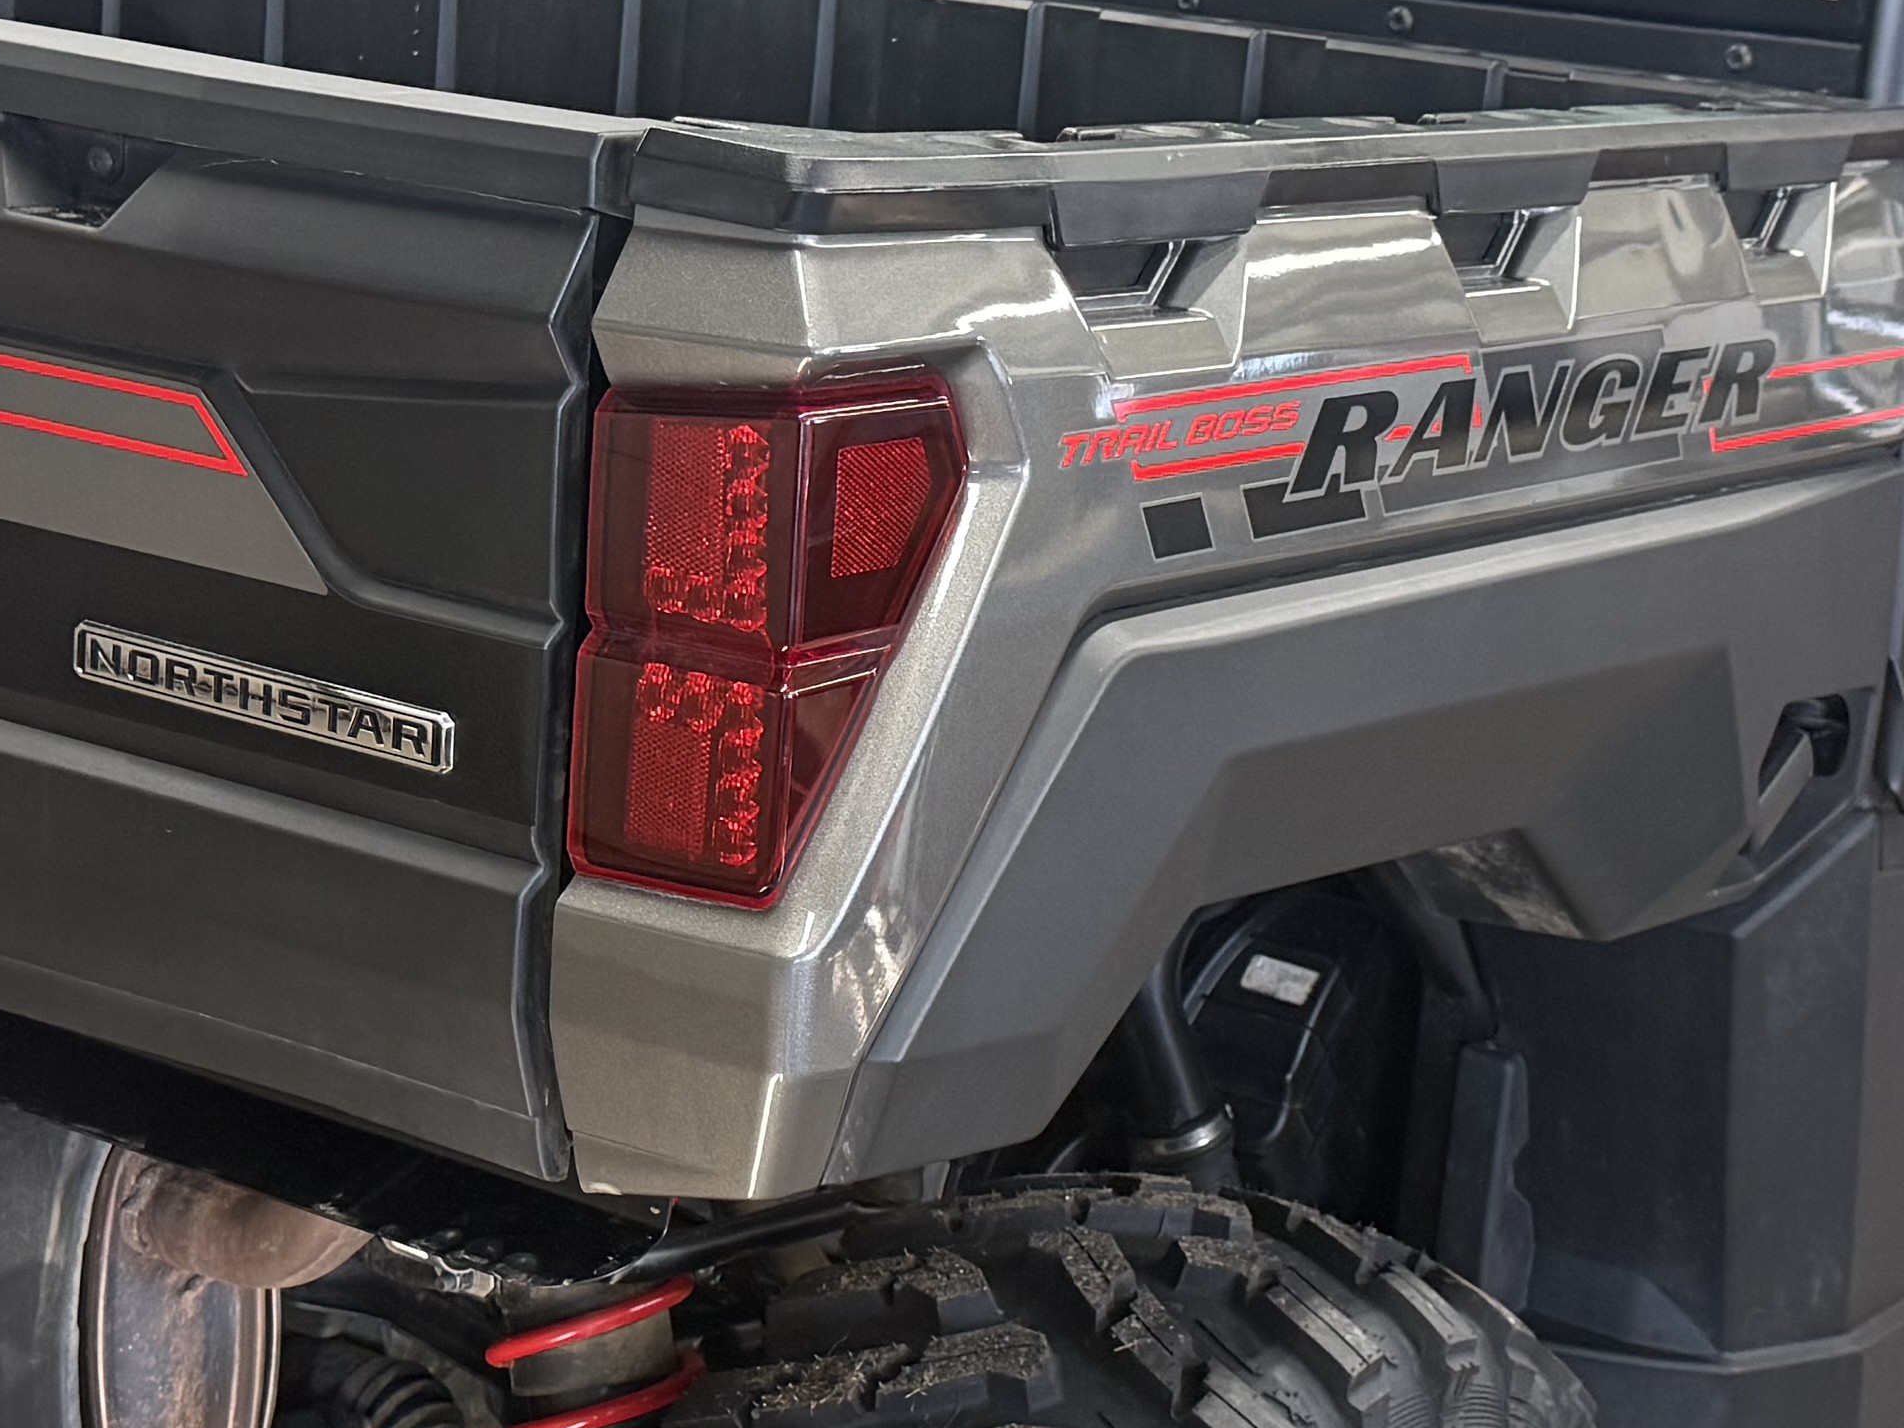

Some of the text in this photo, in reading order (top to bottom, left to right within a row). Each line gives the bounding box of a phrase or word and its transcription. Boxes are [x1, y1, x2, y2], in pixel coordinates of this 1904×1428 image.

[1058, 399, 1303, 469] TRAIL BOSS
[1282, 331, 1781, 502] RANGER
[88, 635, 430, 759] NORTHSTAR
